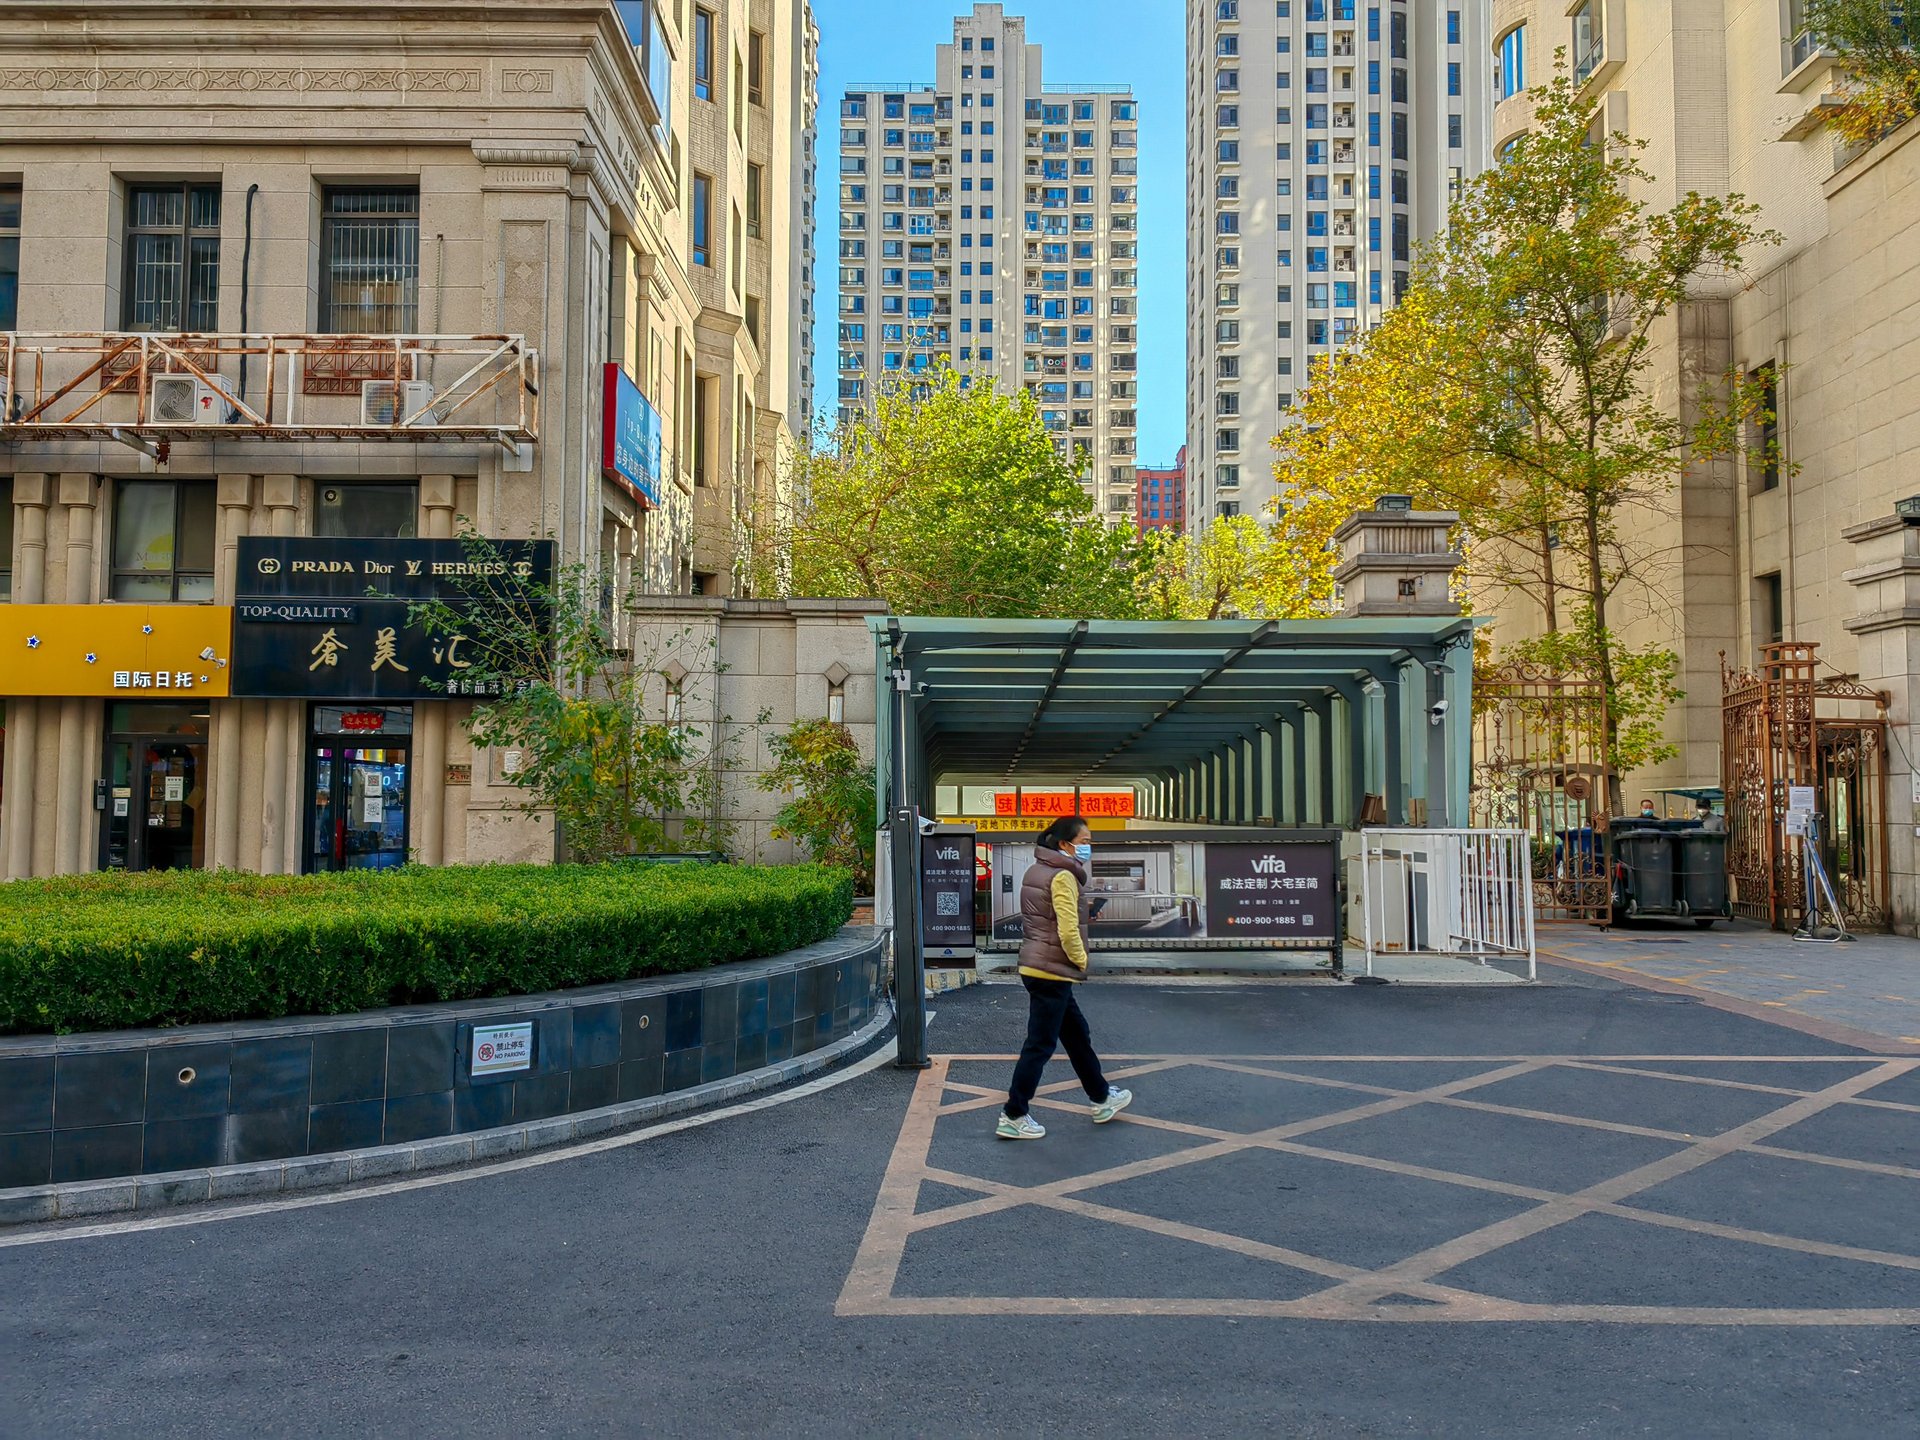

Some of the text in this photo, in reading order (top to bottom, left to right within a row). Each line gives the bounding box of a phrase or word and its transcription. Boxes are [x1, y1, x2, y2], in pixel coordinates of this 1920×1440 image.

[291, 560, 355, 574] PRADA
[364, 559, 395, 574] Dior
[241, 604, 352, 620] TOP-QUALITY
[113, 670, 193, 688] 国际日托
[936, 847, 960, 860] vifa
[1251, 855, 1286, 873] vifa
[1220, 878, 1318, 890] 威法定制 大宅至简
[1235, 916, 1296, 925] 400-900-1885
[496, 1040, 525, 1052] 禁止停车
[504, 1051, 526, 1059] PARKING
